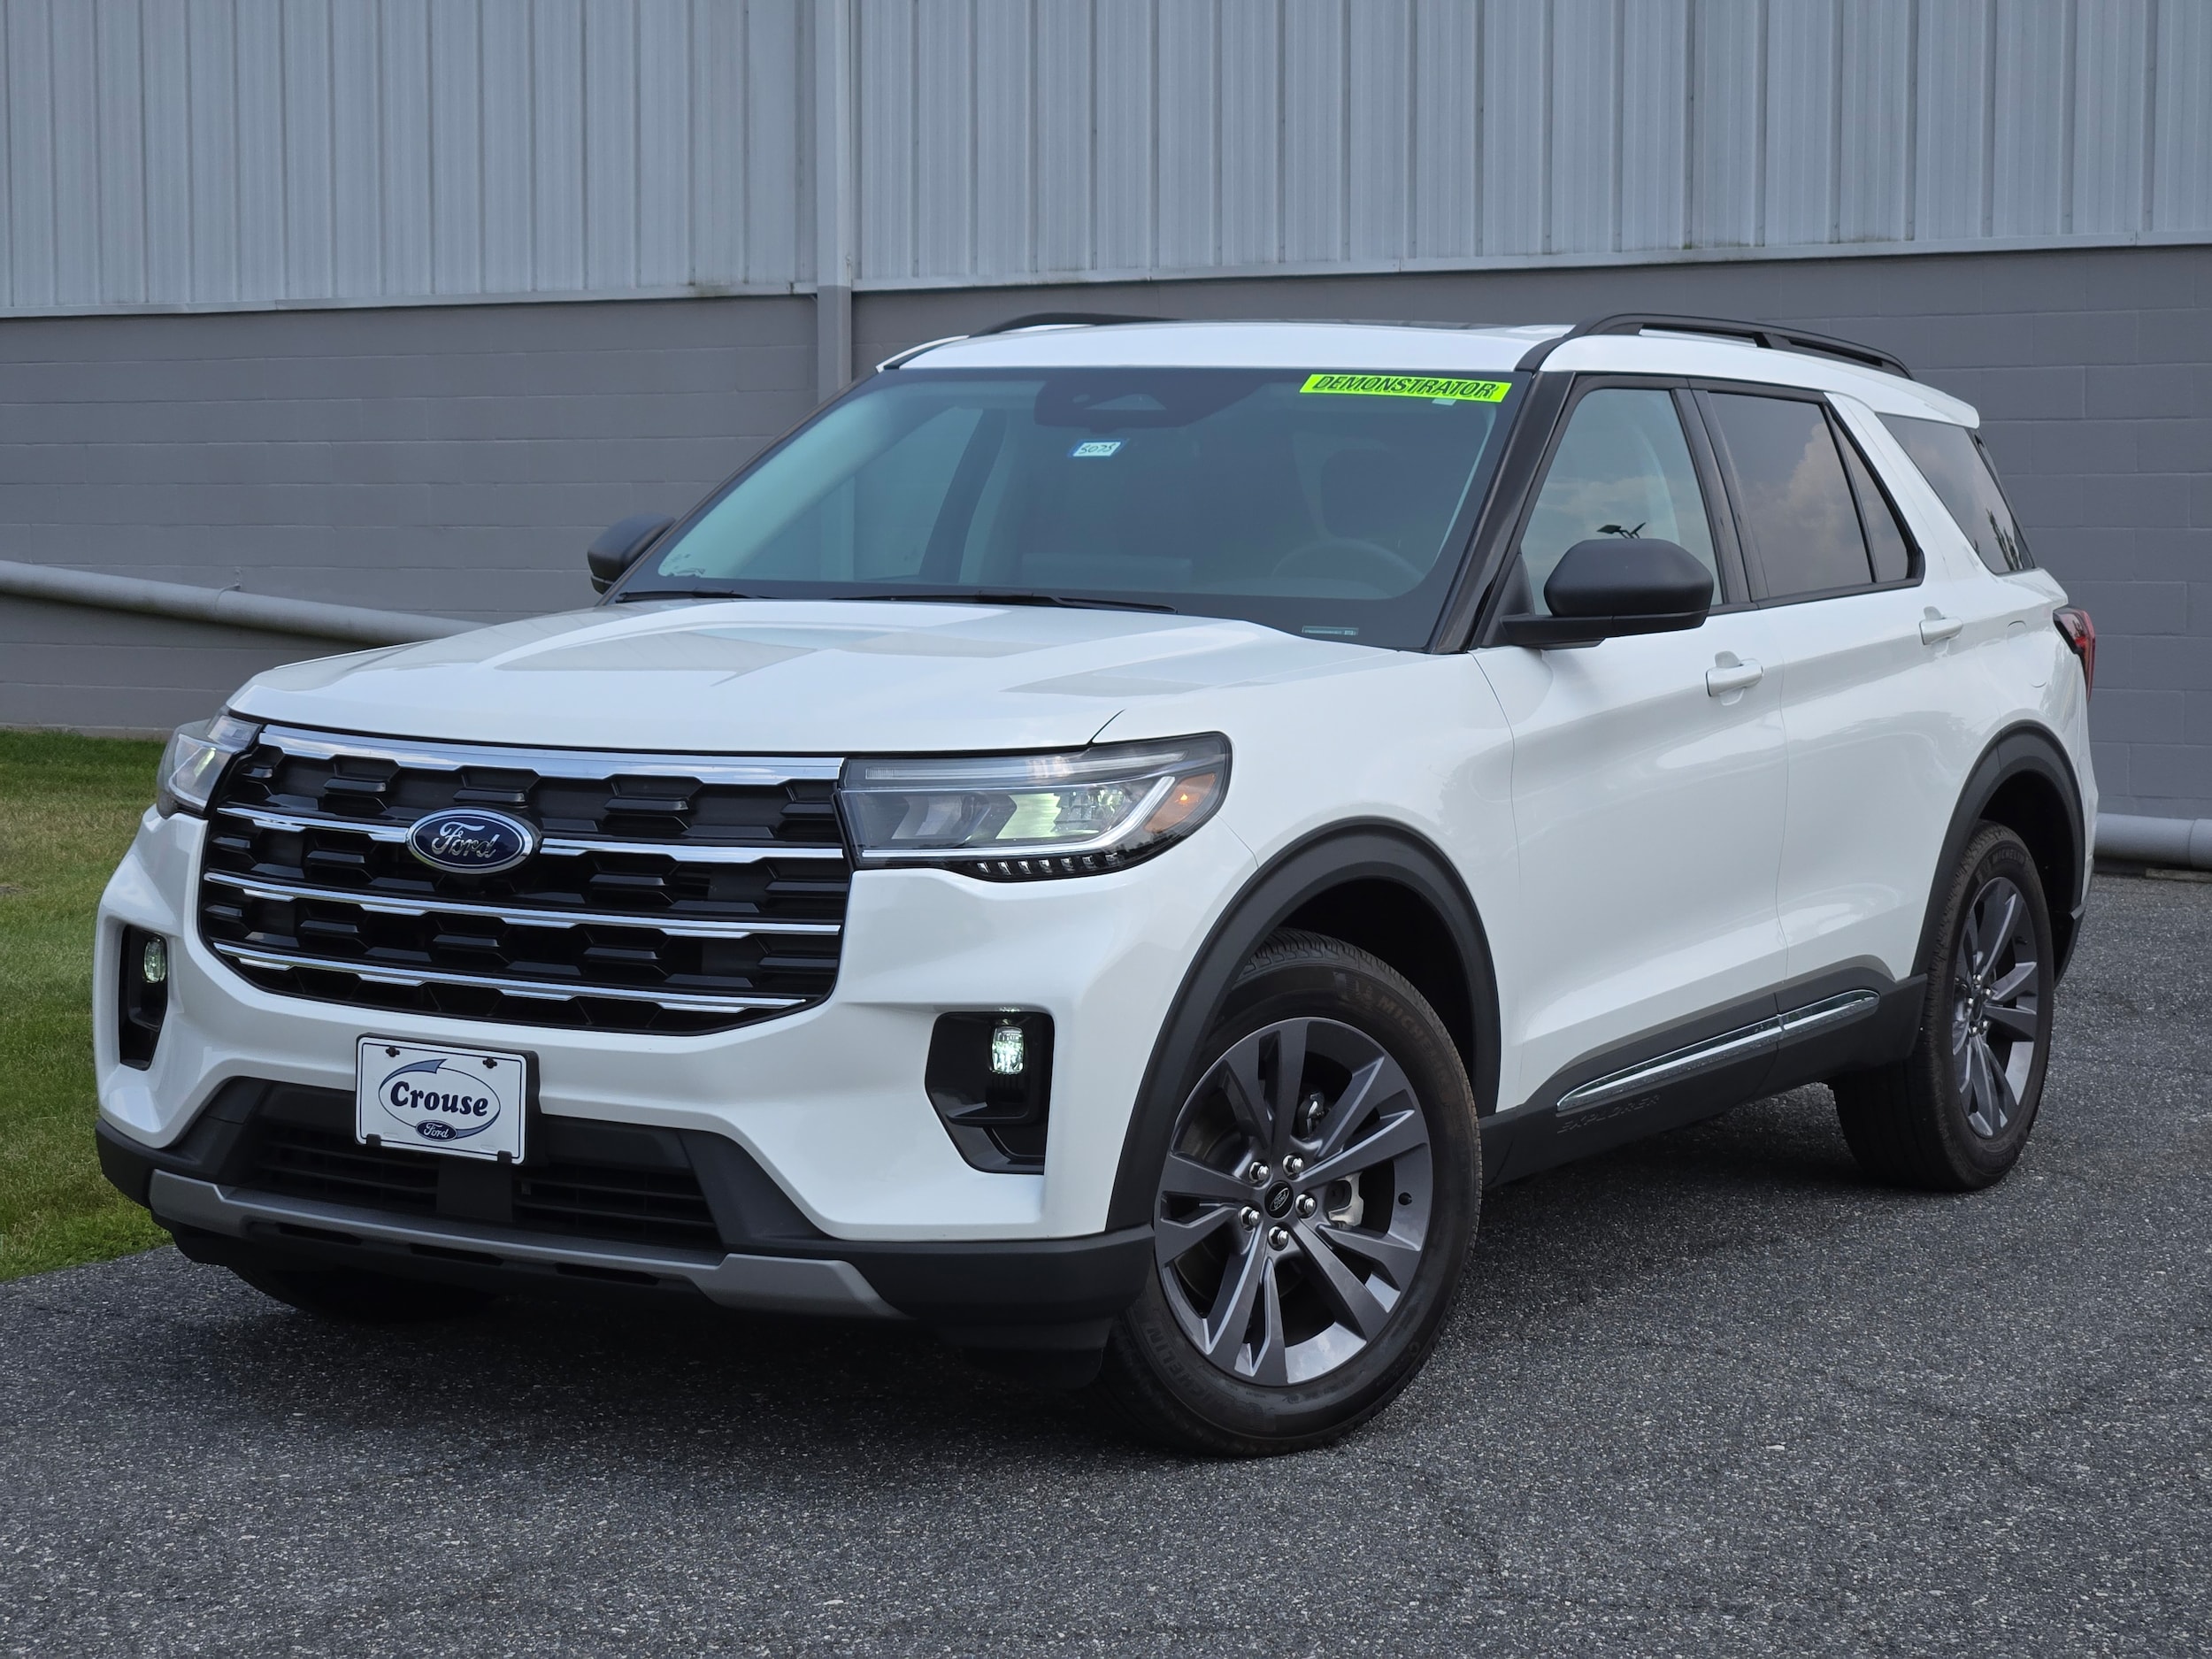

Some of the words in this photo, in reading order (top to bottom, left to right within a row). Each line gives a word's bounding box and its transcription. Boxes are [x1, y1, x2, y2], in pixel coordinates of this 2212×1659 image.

[1312, 375, 1499, 398] DEMONSTRATOR
[431, 821, 500, 858] Ford
[390, 1081, 488, 1117] Crouse
[423, 1123, 449, 1138] Ford
